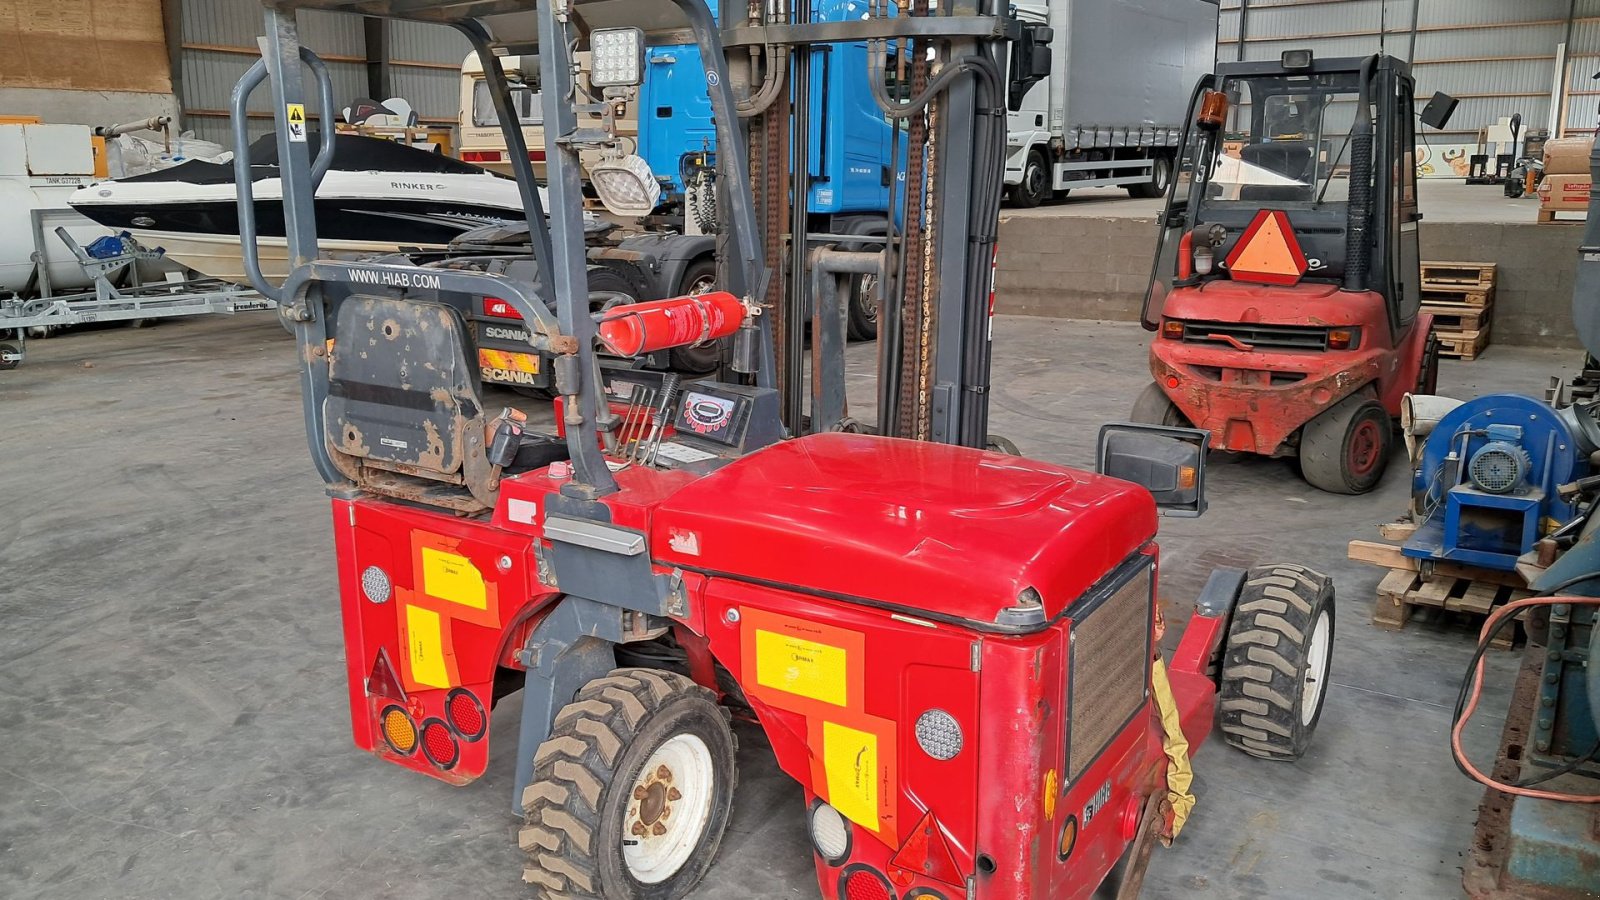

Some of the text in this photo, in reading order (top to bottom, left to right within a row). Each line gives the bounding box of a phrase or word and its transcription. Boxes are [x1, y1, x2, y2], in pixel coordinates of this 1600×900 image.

[390, 181, 434, 191] RINKER
[485, 327, 529, 342] SCANIA
[482, 367, 535, 385] SCANIA
